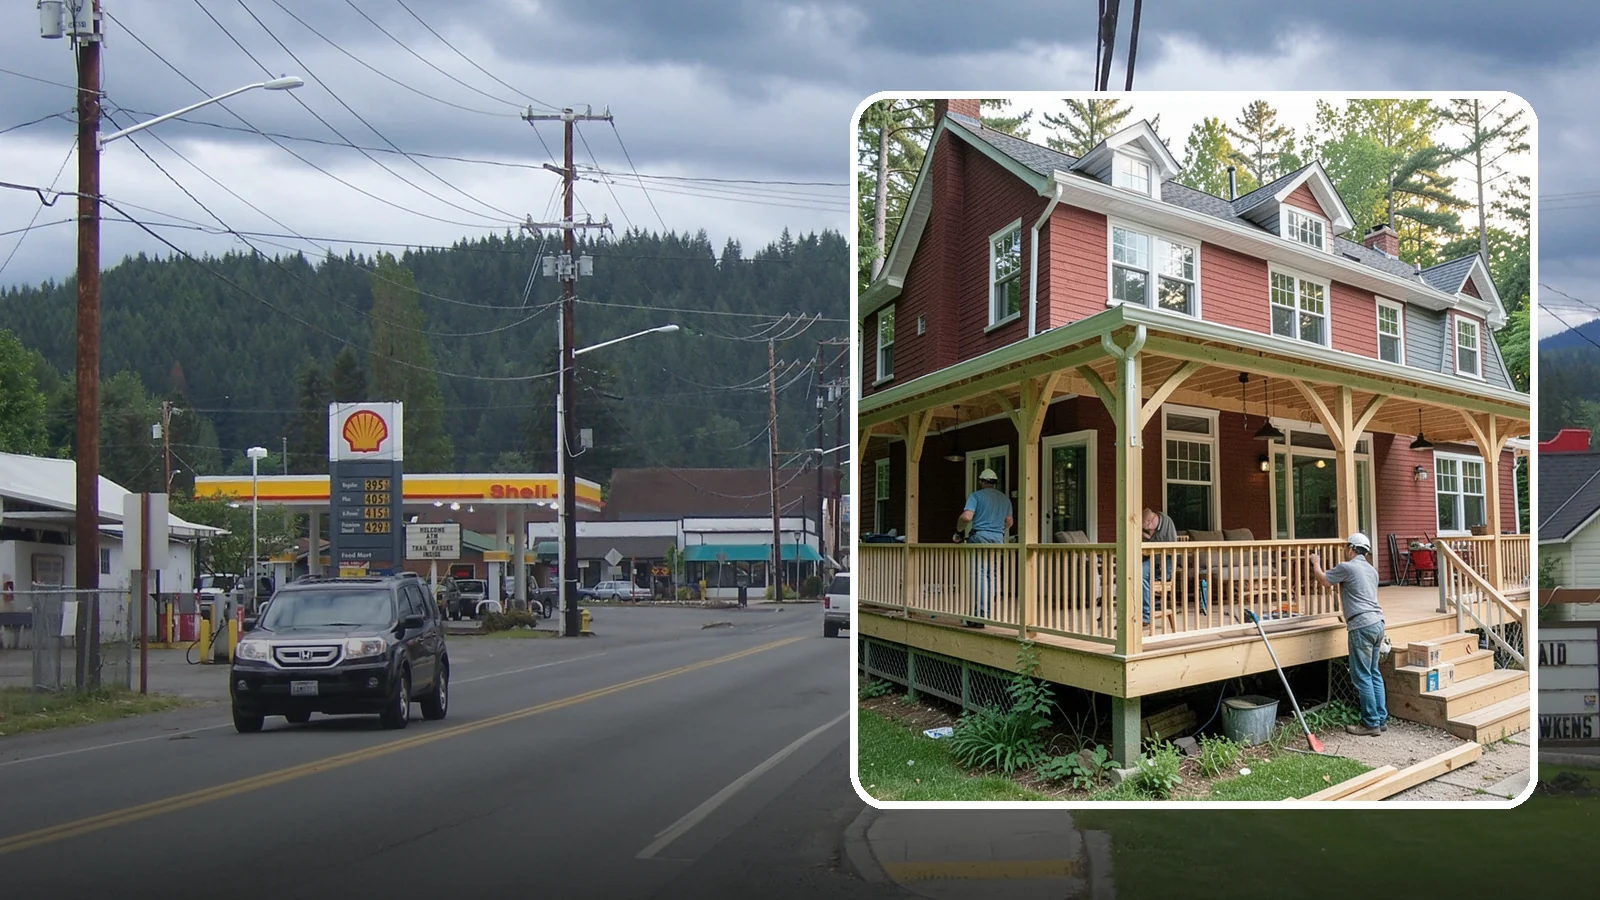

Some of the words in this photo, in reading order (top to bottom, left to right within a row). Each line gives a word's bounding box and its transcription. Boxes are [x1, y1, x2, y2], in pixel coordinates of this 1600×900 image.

[366, 480, 383, 490] 395
[490, 484, 547, 499] Shell
[366, 494, 383, 504] 405
[366, 508, 383, 518] 415
[366, 522, 383, 532] 429
